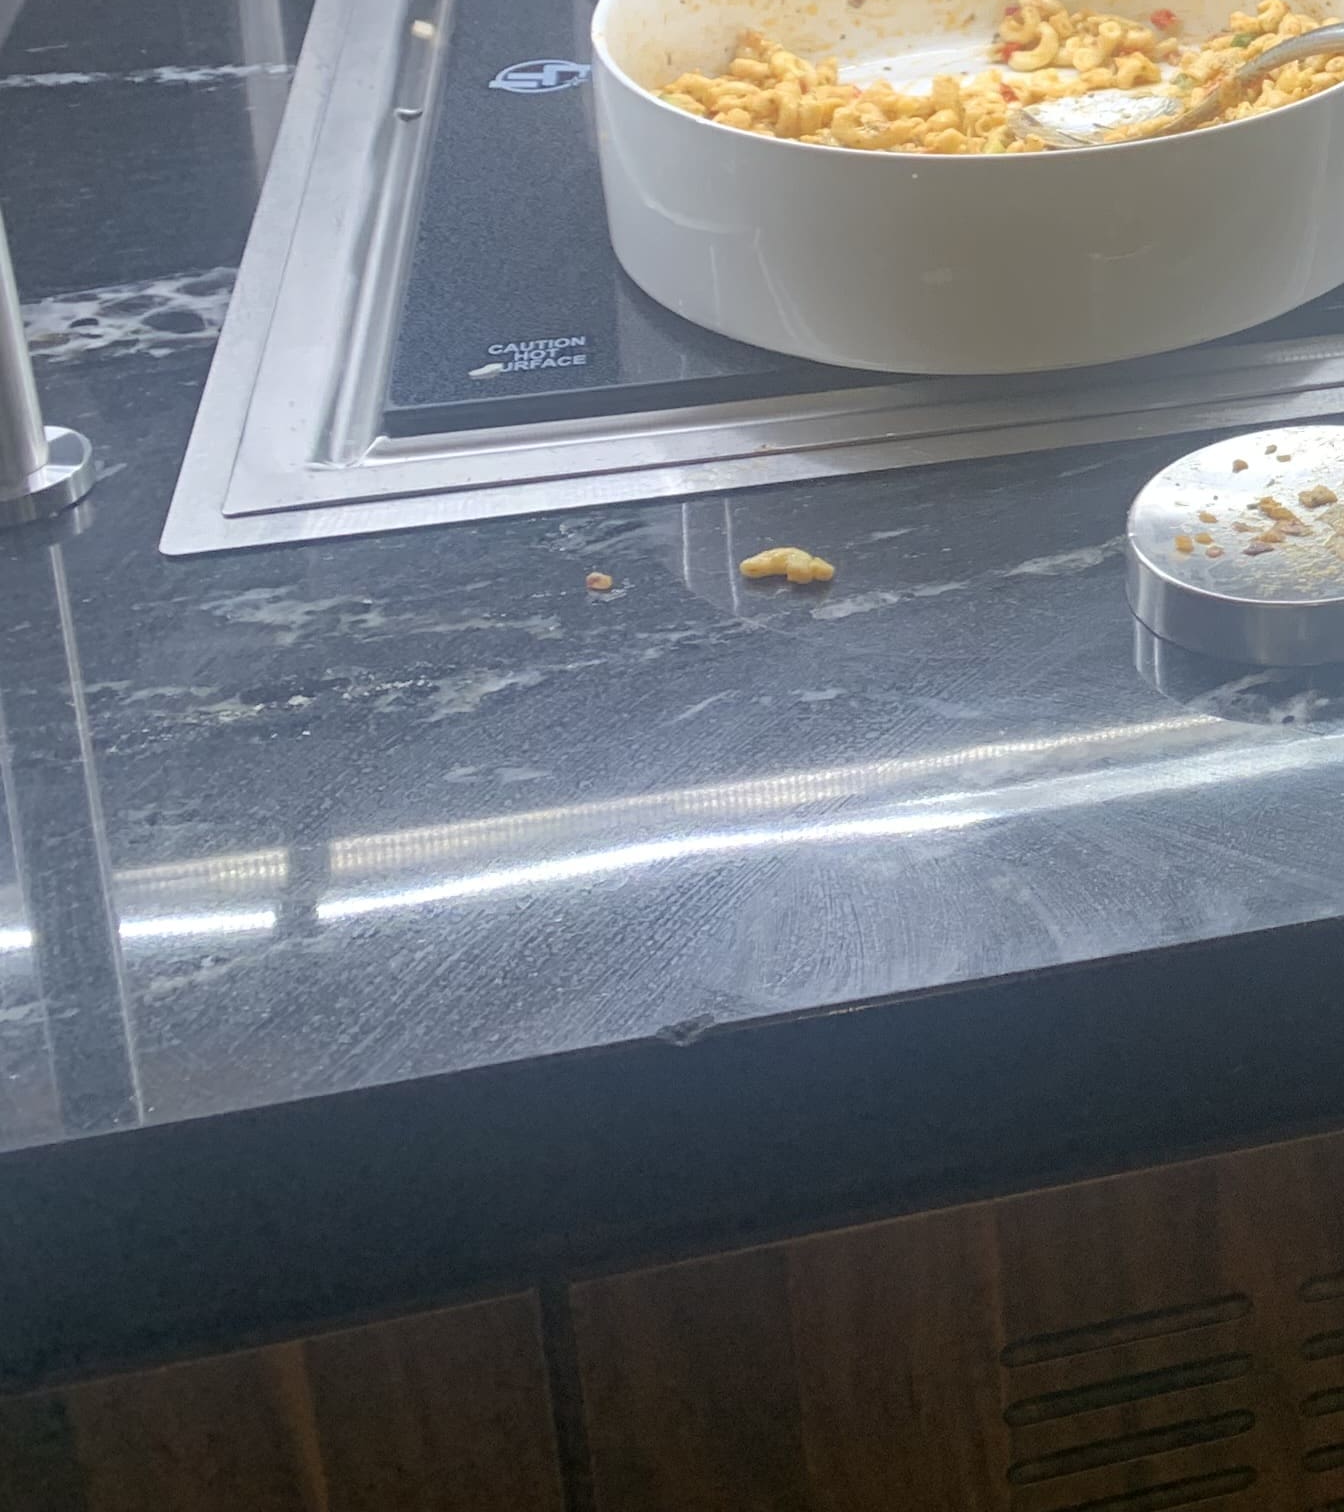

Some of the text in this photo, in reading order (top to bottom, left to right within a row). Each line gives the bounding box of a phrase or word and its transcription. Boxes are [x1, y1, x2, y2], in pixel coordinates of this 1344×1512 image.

[487, 336, 587, 355] CAUTION
[497, 354, 588, 373] URFACE
[514, 349, 560, 362] HOT
